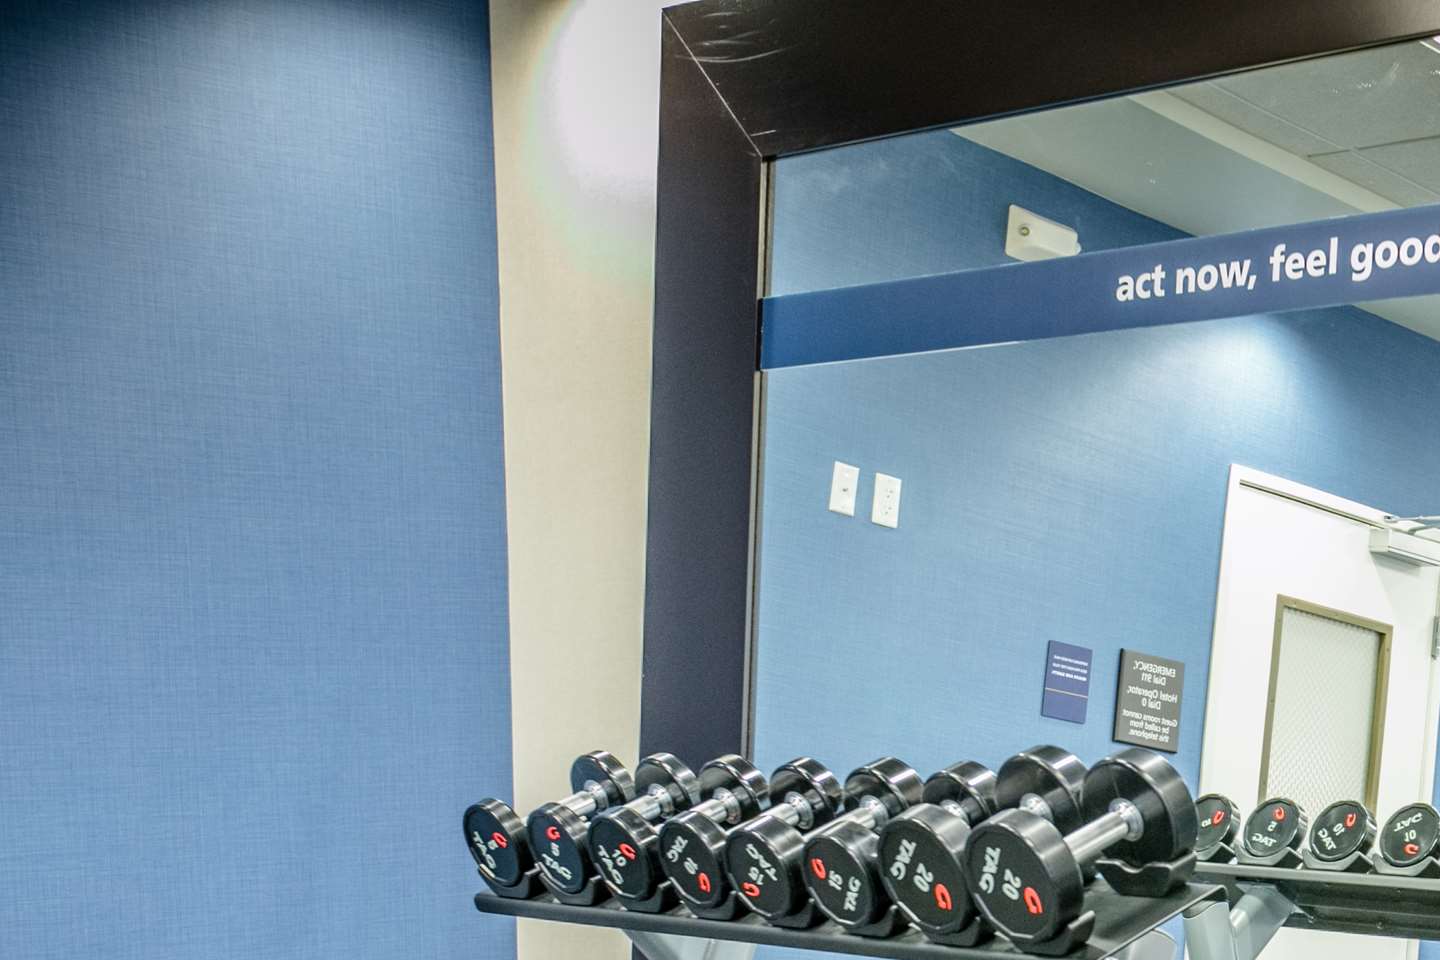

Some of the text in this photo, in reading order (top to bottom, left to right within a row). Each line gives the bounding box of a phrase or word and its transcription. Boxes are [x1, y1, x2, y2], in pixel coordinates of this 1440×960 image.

[1115, 264, 1165, 302] act
[1174, 258, 1257, 292] now,
[1269, 237, 1338, 282] feel
[473, 831, 496, 869] TAG
[598, 845, 624, 885] TAG
[611, 849, 627, 867] 10
[666, 835, 688, 862] TAG
[745, 843, 778, 881] TAG
[889, 838, 917, 880] TAG
[541, 853, 572, 880] TAG
[748, 866, 764, 886] 15
[827, 870, 843, 891] 15
[913, 862, 934, 893] 20
[978, 846, 1001, 894] TAG
[843, 876, 861, 912] TAG
[1002, 868, 1022, 900] 20
